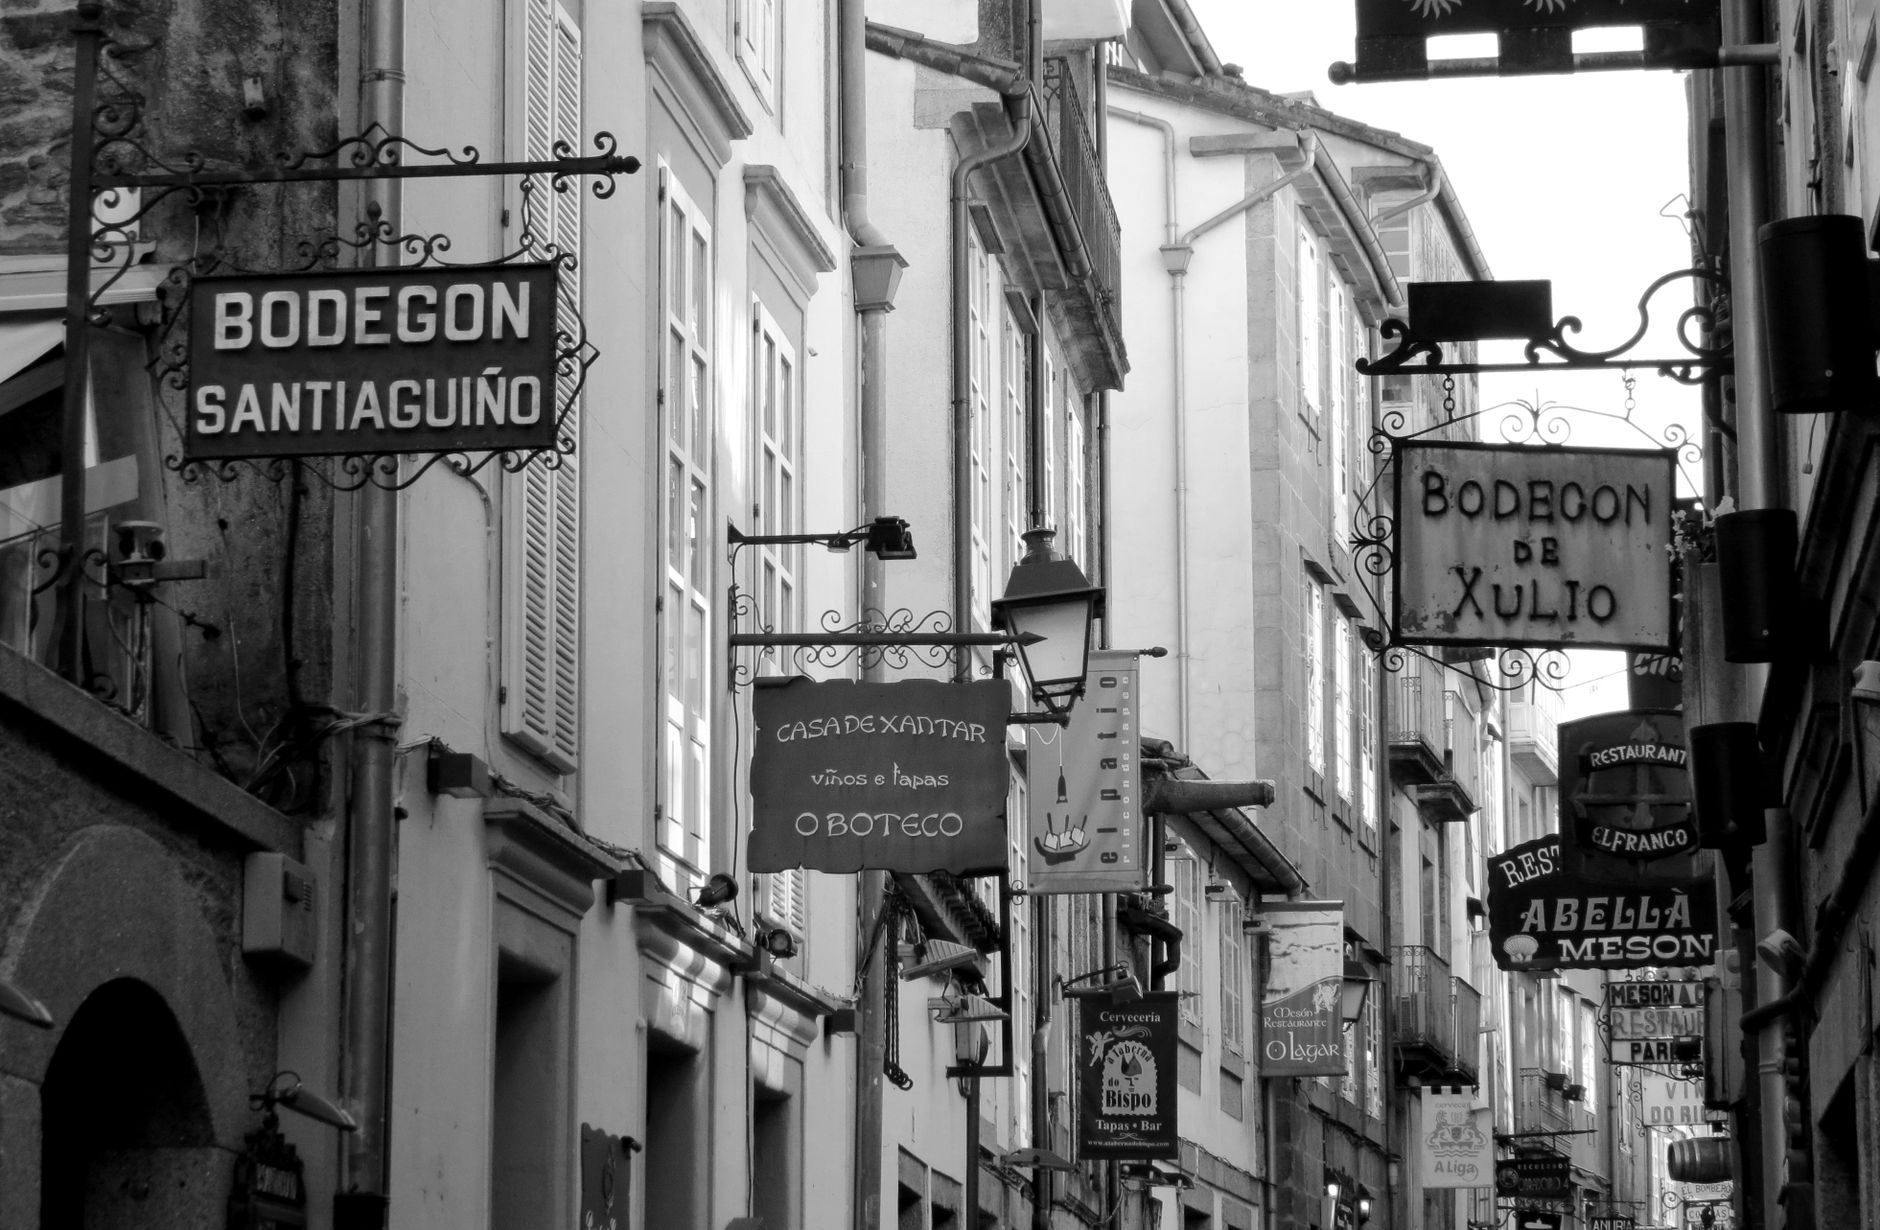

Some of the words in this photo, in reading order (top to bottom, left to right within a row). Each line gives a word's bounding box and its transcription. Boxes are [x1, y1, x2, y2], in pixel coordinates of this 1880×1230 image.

[214, 282, 530, 350] BODEGON
[196, 367, 541, 434] SANTIAGUIÑO
[1514, 537, 1560, 565] DE
[1453, 566, 1616, 621] XULIO
[777, 717, 841, 743] CASA
[844, 715, 876, 733] DE
[879, 715, 986, 743] XANTAR
[873, 774, 885, 786] e
[893, 762, 949, 790] tapas
[795, 812, 819, 836] O
[826, 812, 963, 837] BOTECO
[1558, 934, 1713, 962] MESON
[1611, 984, 1674, 1005] MESON
[1100, 1011, 1161, 1023] Cervecería
[1631, 1042, 1674, 1061] PAR
[1108, 1077, 1120, 1087] do
[1105, 1089, 1151, 1111] Bispo
[1095, 1119, 1130, 1133] Tapas
[1141, 1120, 1162, 1131] Bar
[1434, 1161, 1444, 1173] A
